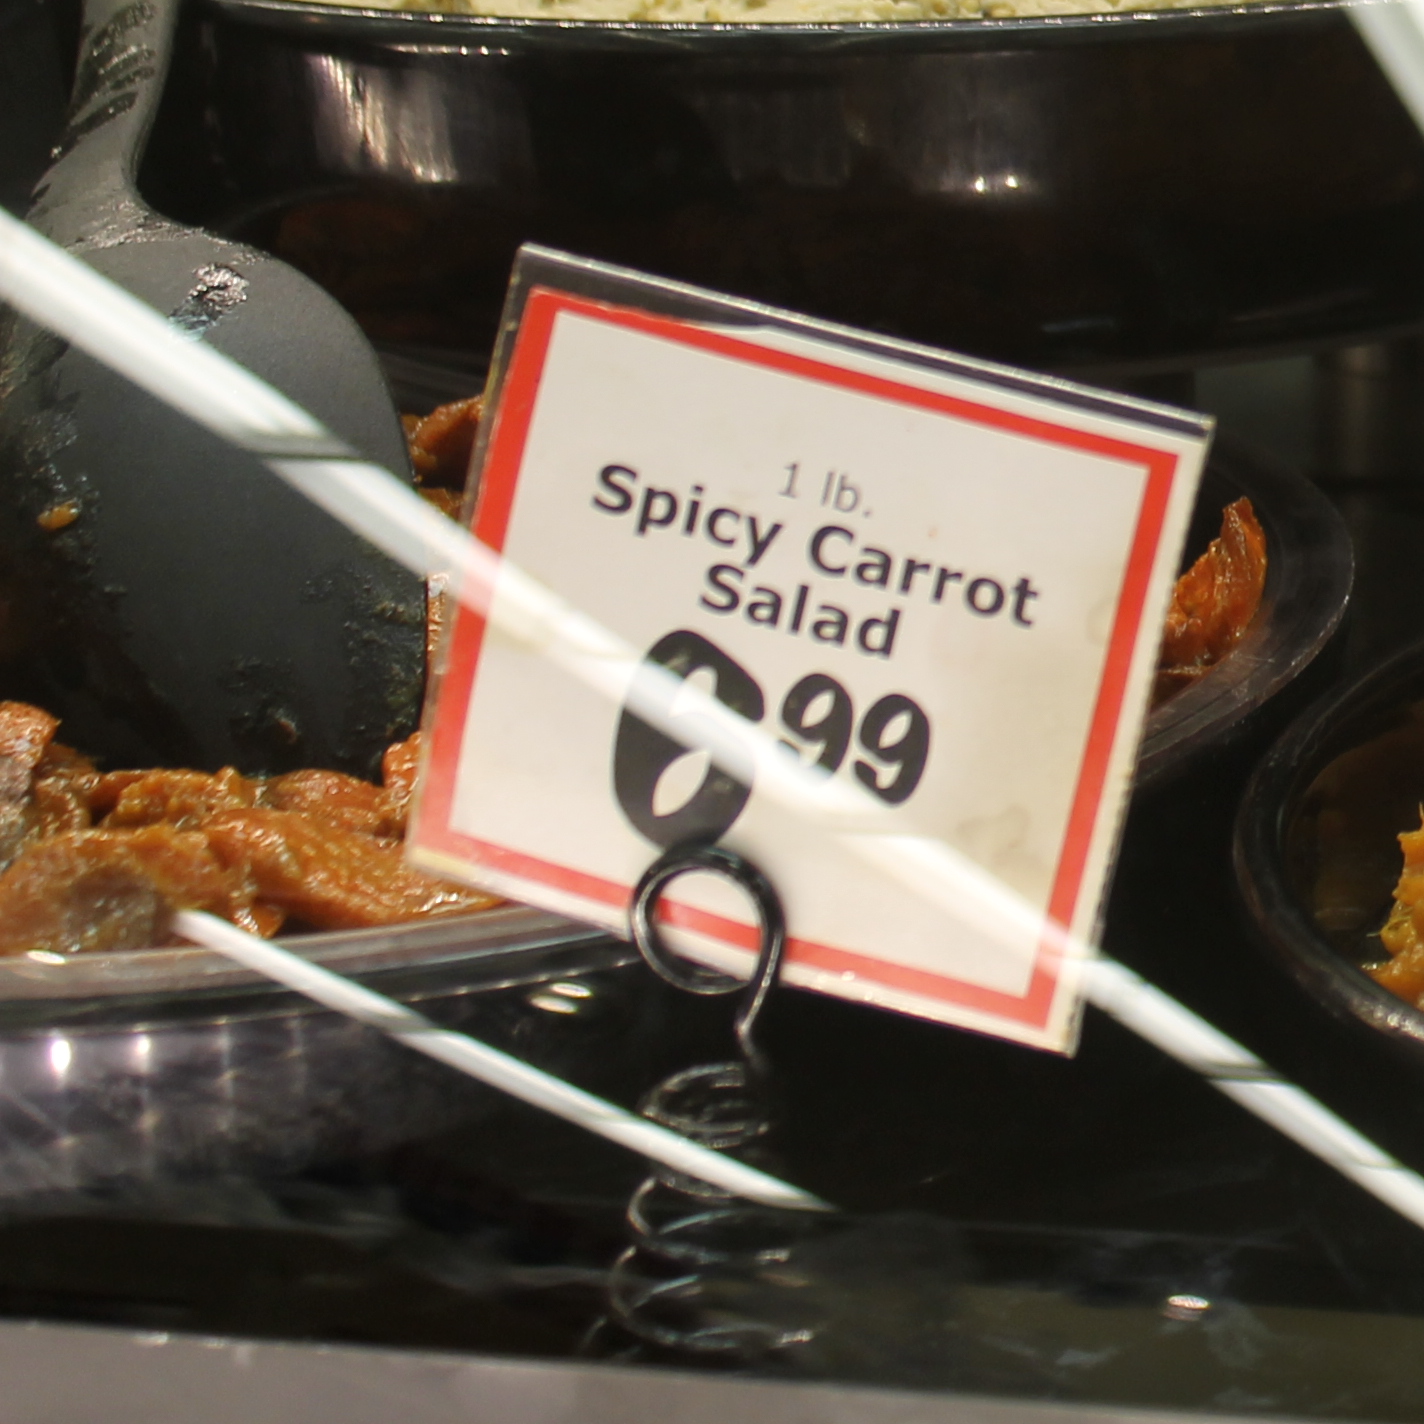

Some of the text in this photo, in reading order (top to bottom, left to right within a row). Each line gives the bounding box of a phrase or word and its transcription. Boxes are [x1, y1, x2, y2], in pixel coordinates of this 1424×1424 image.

[777, 461, 874, 519] 1 lb.
[590, 464, 1043, 629] Spicy Carrot
[699, 563, 903, 659] Salad
